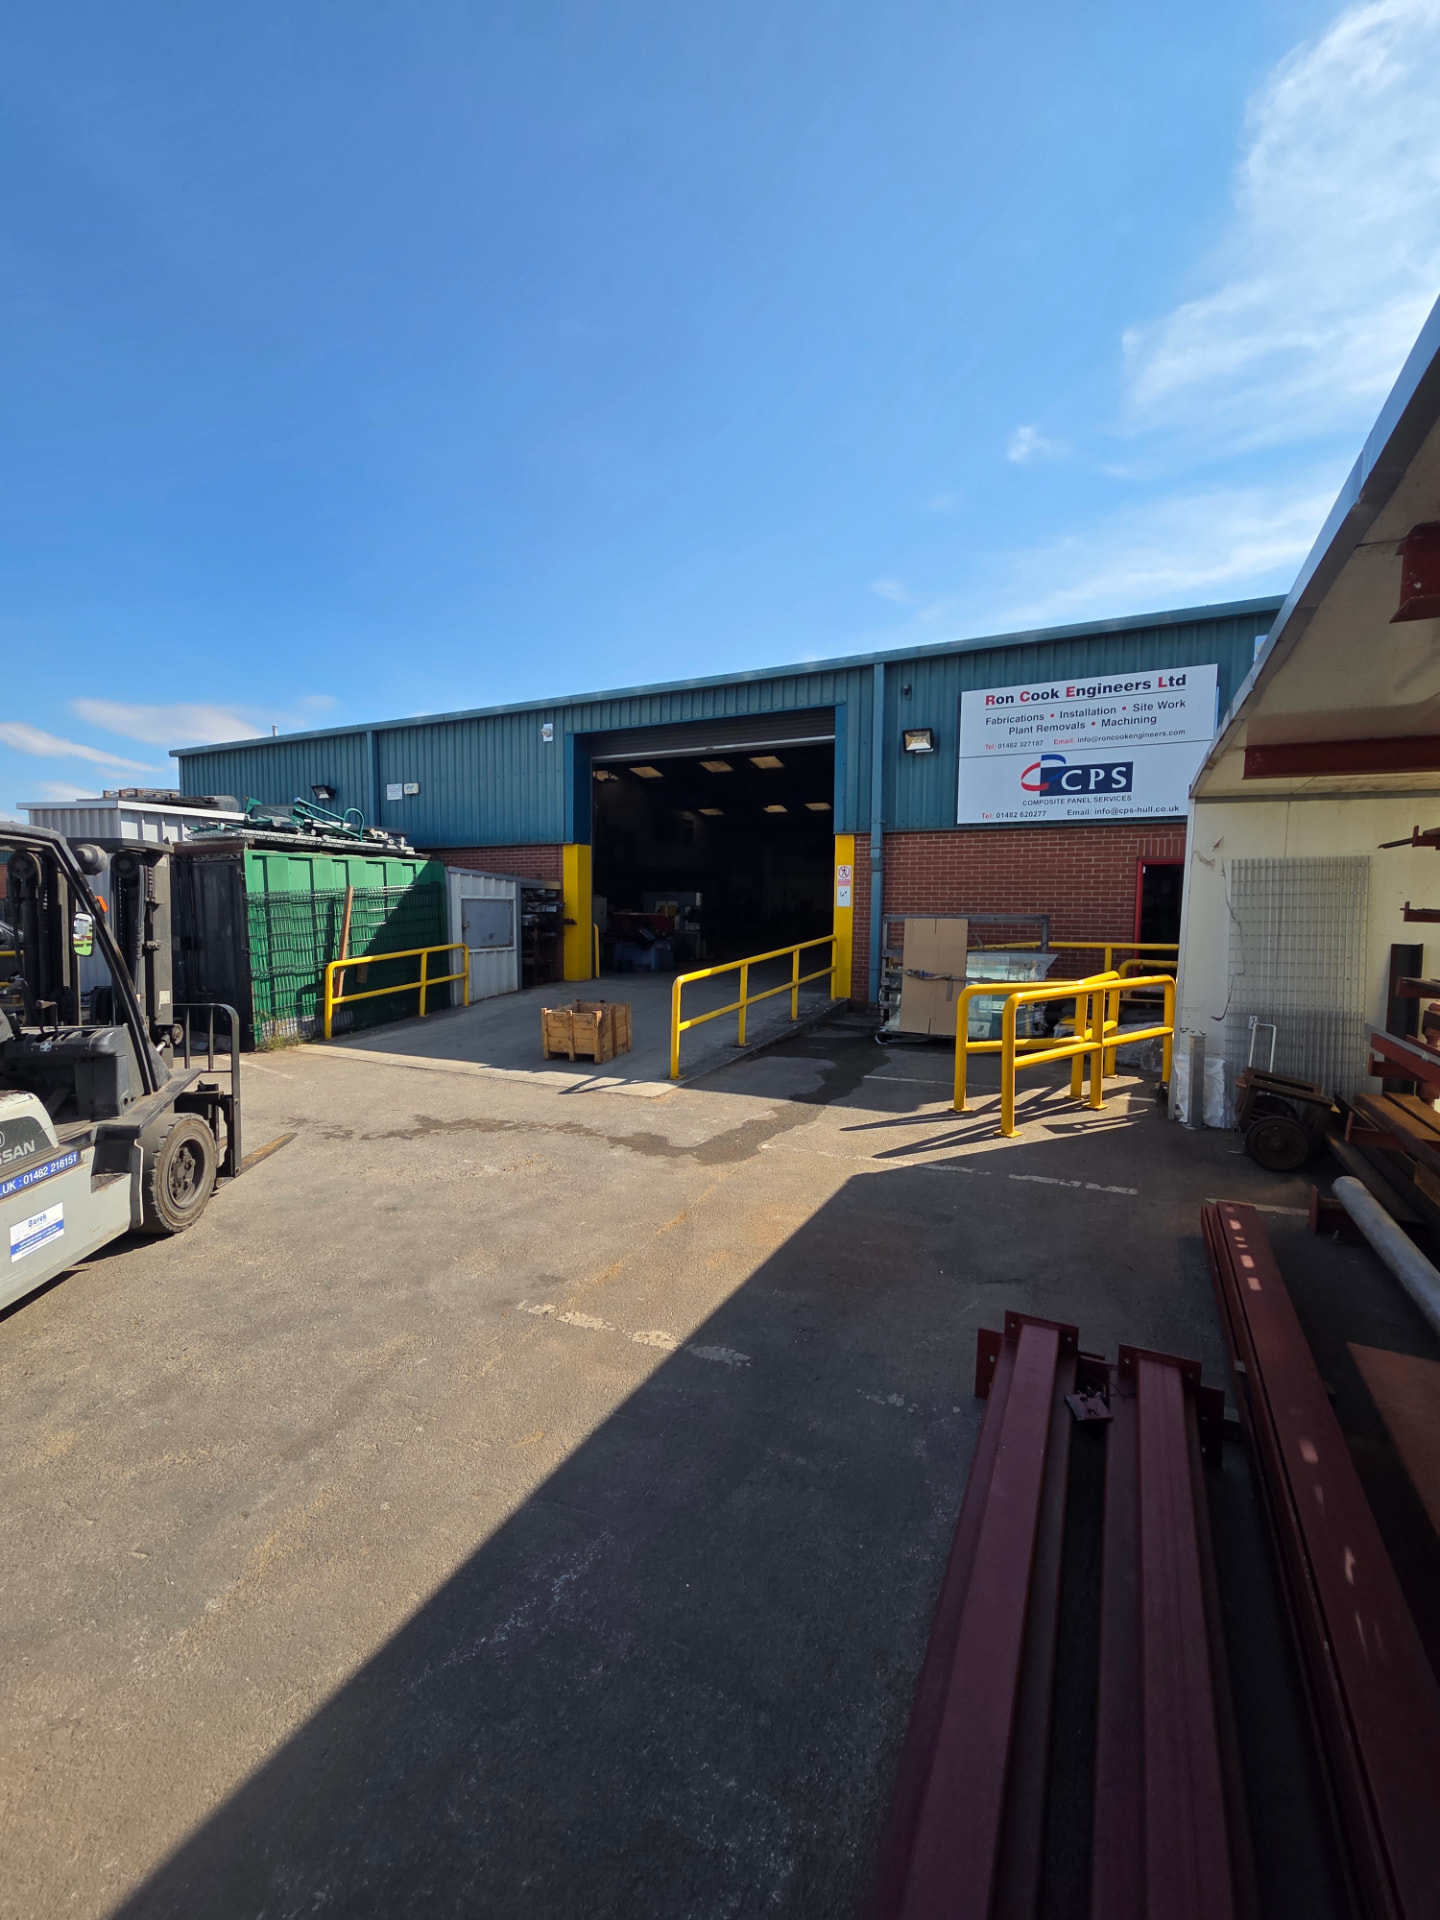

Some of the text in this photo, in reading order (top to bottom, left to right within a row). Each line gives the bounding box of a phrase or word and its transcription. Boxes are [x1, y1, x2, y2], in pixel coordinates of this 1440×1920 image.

[985, 674, 1187, 706] Ron Cook Engineers Ltd
[985, 699, 1187, 725] Fabrications Installation Site Work
[1008, 716, 1157, 735] Plant Removals Machining
[1019, 740, 1044, 748] 327187
[1053, 737, 1075, 745] Email:
[1077, 729, 1186, 744] info@roncookengineers.com
[1061, 766, 1127, 791] CPS
[981, 804, 1180, 820] Tel: 01482 620277 Email: info@cps-hull.co.uk
[1022, 794, 1132, 807] COMPOSITE PANEL SERVICES
[0, 1139, 35, 1166] SAN
[23, 1166, 49, 1185] 01482
[50, 1153, 77, 1173] 218151
